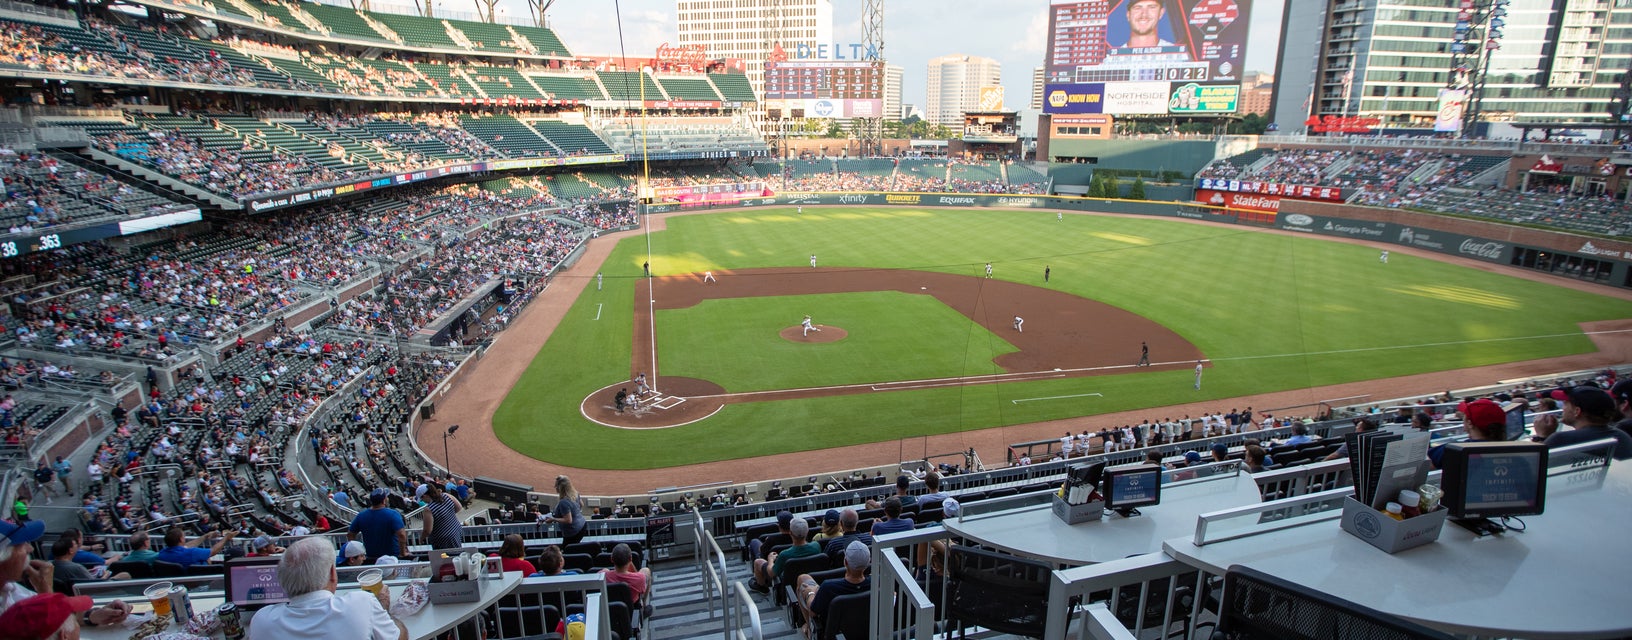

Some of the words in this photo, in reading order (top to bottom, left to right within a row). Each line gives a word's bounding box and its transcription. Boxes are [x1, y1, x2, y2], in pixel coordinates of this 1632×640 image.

[797, 43, 879, 59] DELTA
[1169, 68, 1177, 79] 0
[1183, 68, 1191, 79] 2
[1197, 67, 1205, 79] 2
[1068, 94, 1086, 103] KNOW
[1086, 93, 1101, 103] HOW
[1107, 92, 1165, 100] NORTHSIDE
[839, 194, 868, 204] xfinity
[940, 196, 976, 205] EQUIFAX
[1335, 224, 1361, 234] Georgia
[1361, 227, 1384, 236] Power
[38, 233, 62, 251] .363
[0, 241, 18, 258] 38
